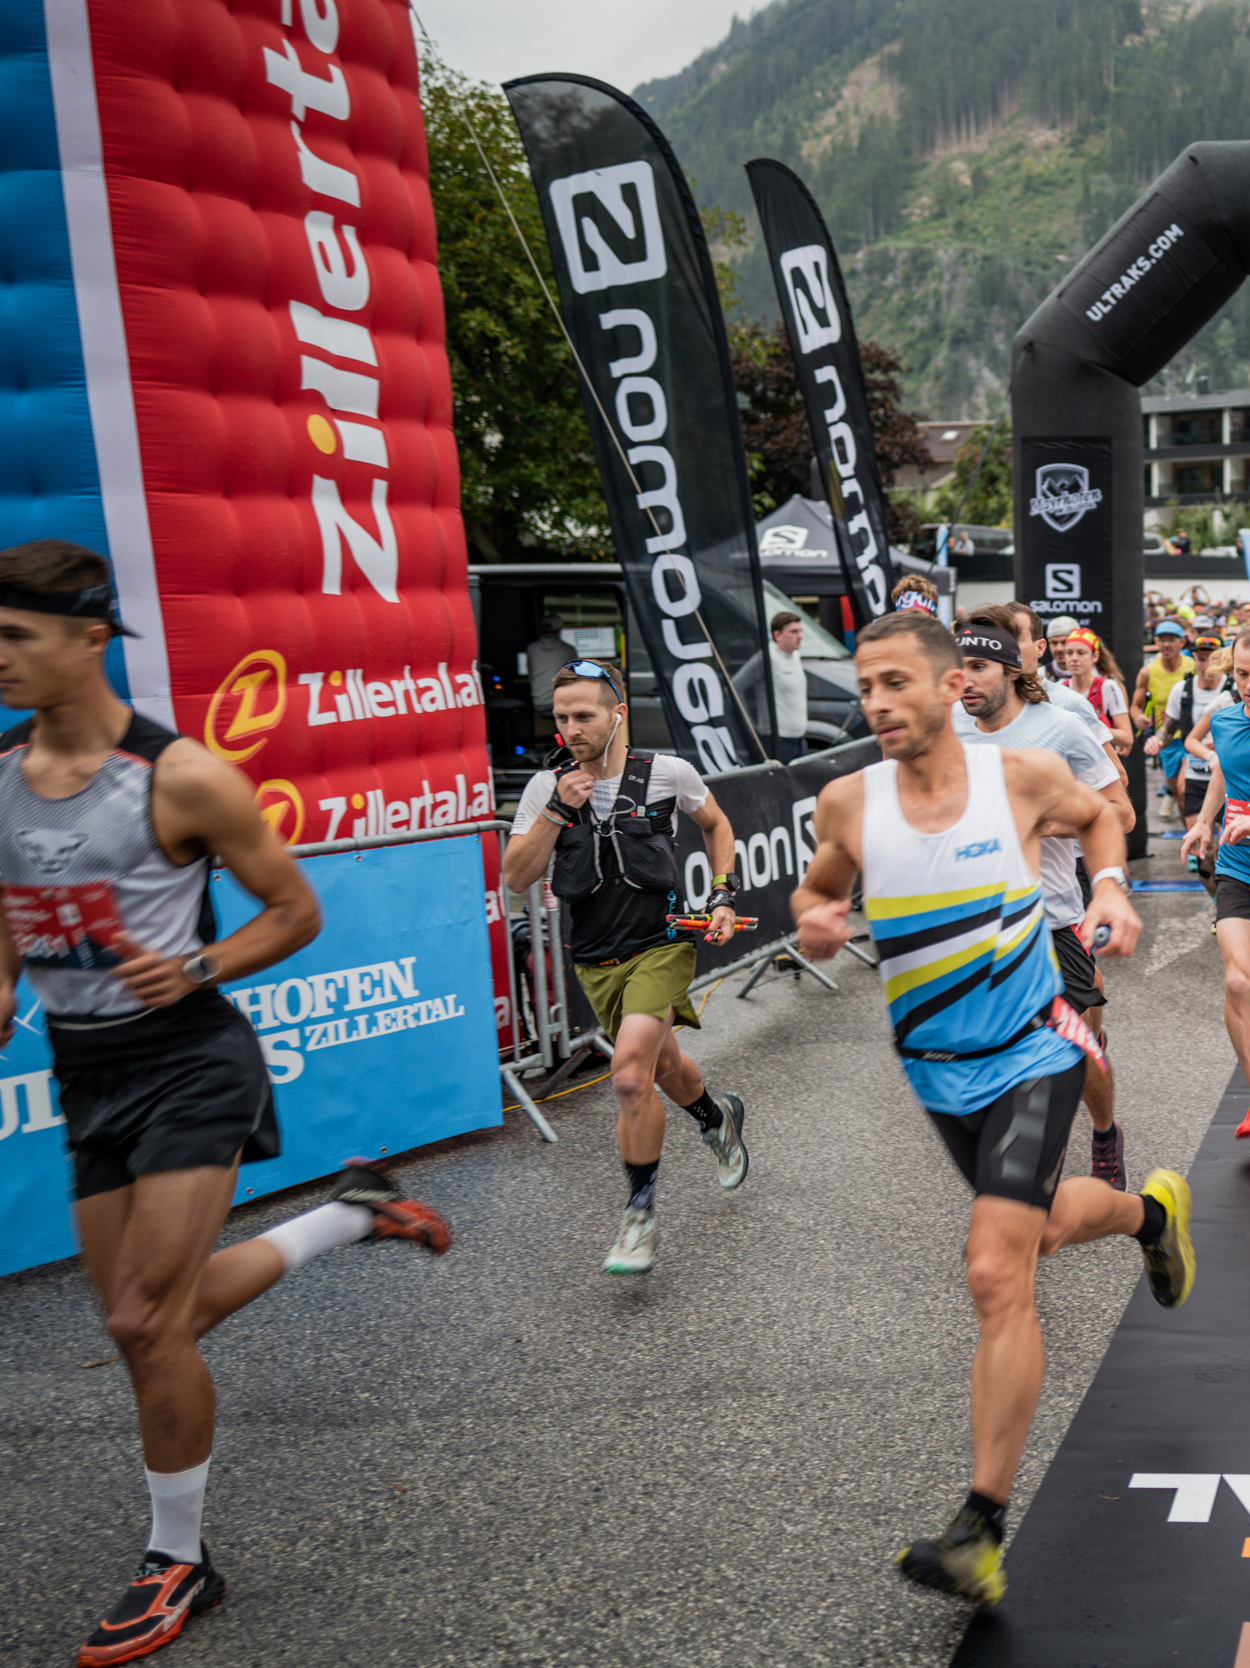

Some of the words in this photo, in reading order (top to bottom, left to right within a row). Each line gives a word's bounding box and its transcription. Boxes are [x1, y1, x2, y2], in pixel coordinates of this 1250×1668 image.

[1086, 222, 1185, 323] ULTRAKS.COM
[1029, 600, 1103, 614] salomon
[955, 632, 1001, 649] UNTO
[297, 659, 487, 727] Zillertal.at
[683, 825, 794, 915] omon
[954, 836, 1002, 863] HOKA
[224, 955, 419, 1032] HOFEN
[304, 993, 466, 1052] ZILLERTAL
